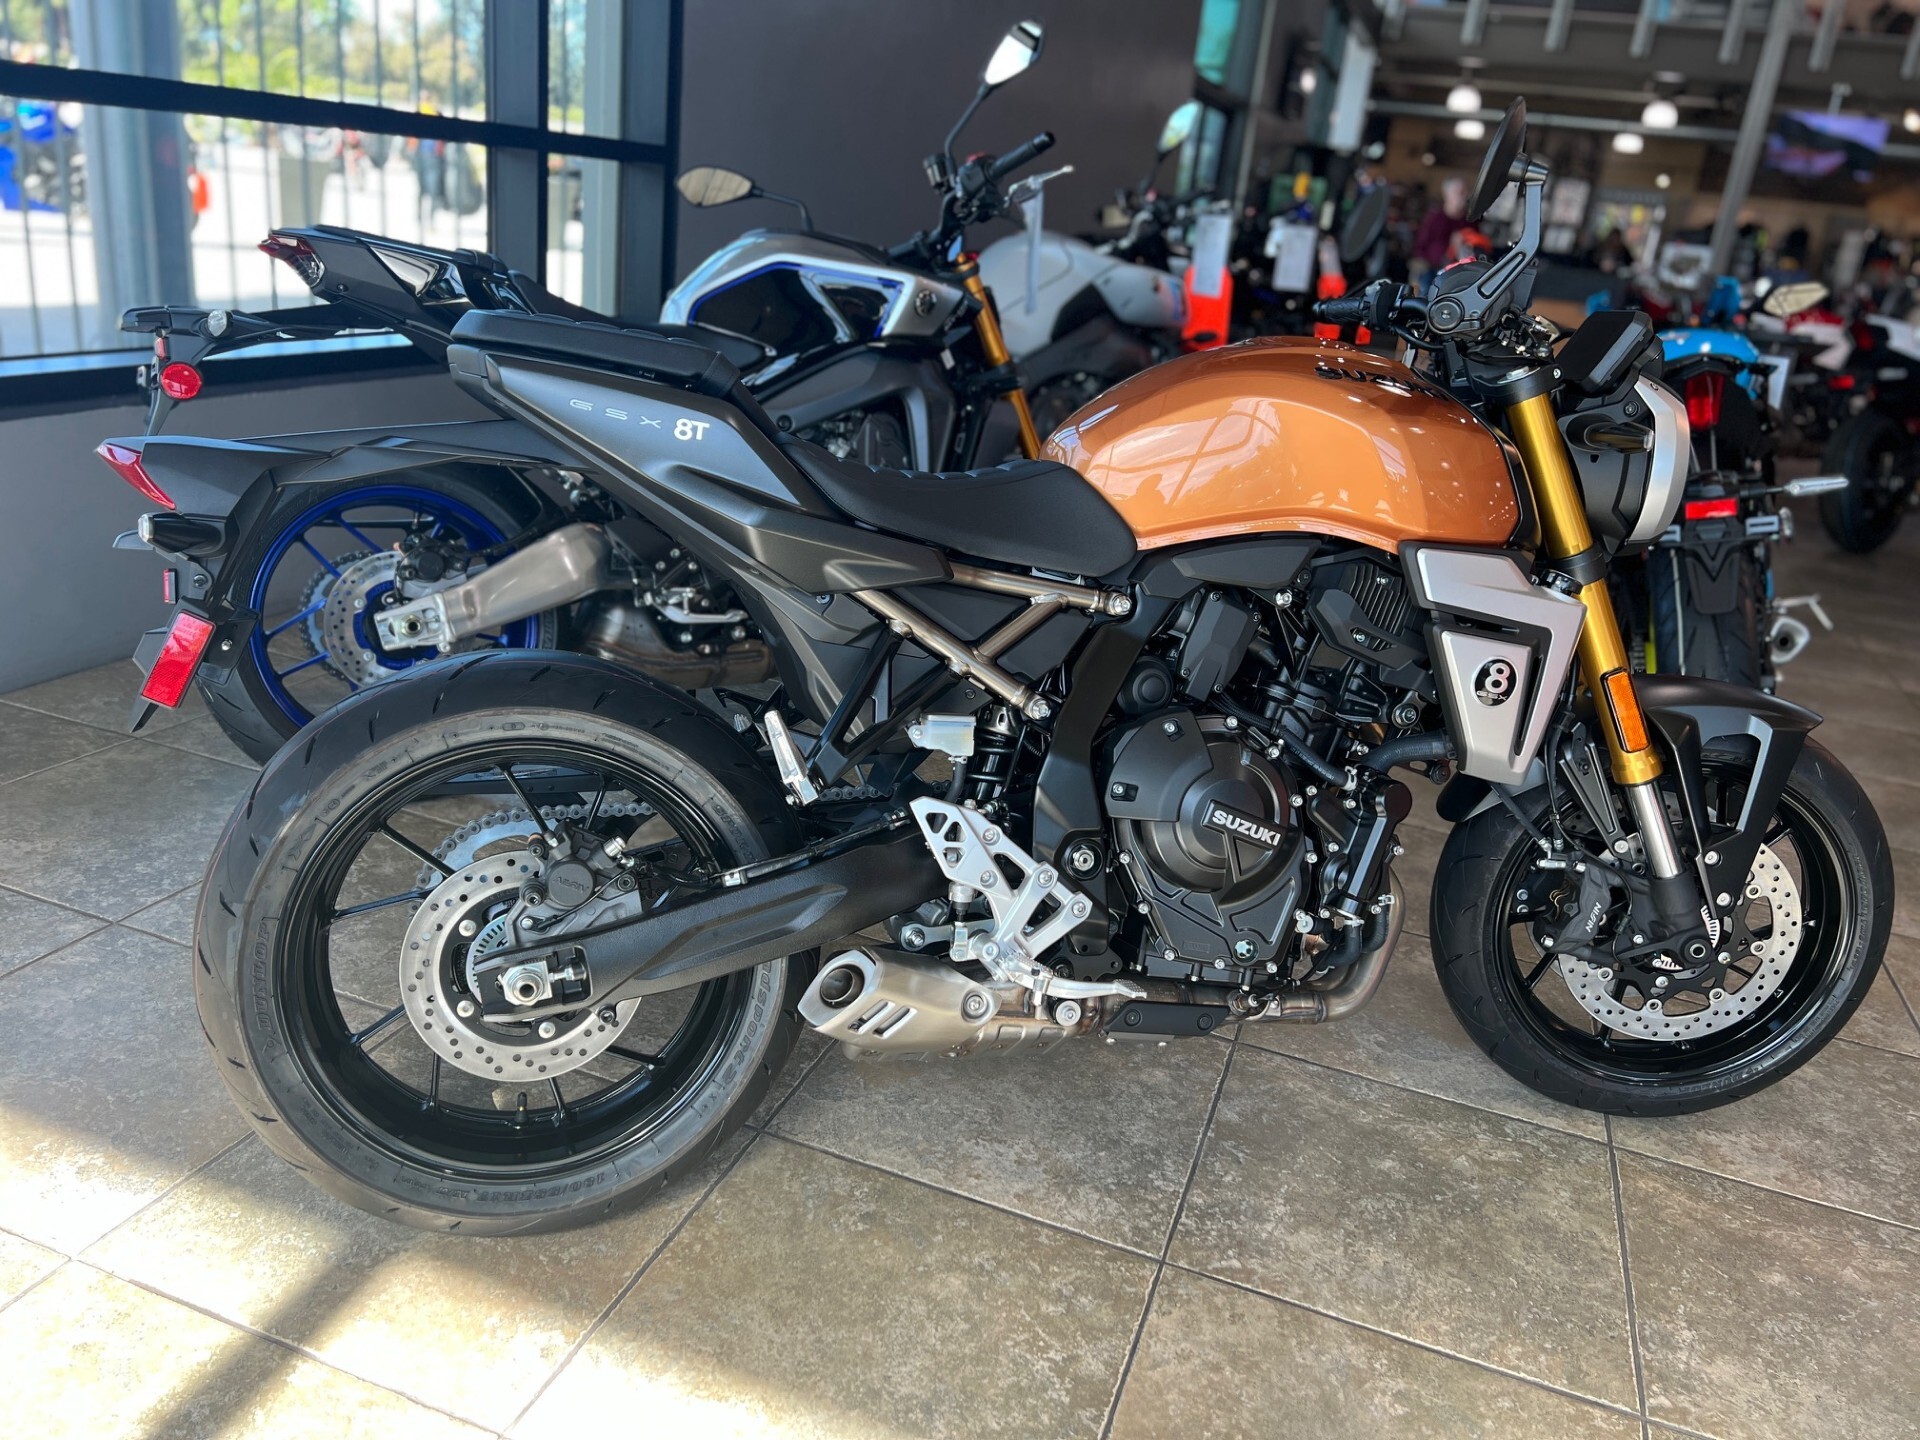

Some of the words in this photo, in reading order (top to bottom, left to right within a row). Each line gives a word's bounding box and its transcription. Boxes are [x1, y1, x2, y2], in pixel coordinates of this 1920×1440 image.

[569, 398, 662, 430] GSX
[673, 418, 711, 441] 8T
[1484, 662, 1511, 694] 8
[1212, 809, 1281, 847] SUZUKI
[1585, 901, 1602, 933] NISSIN
[253, 921, 273, 1031] DUNLOP
